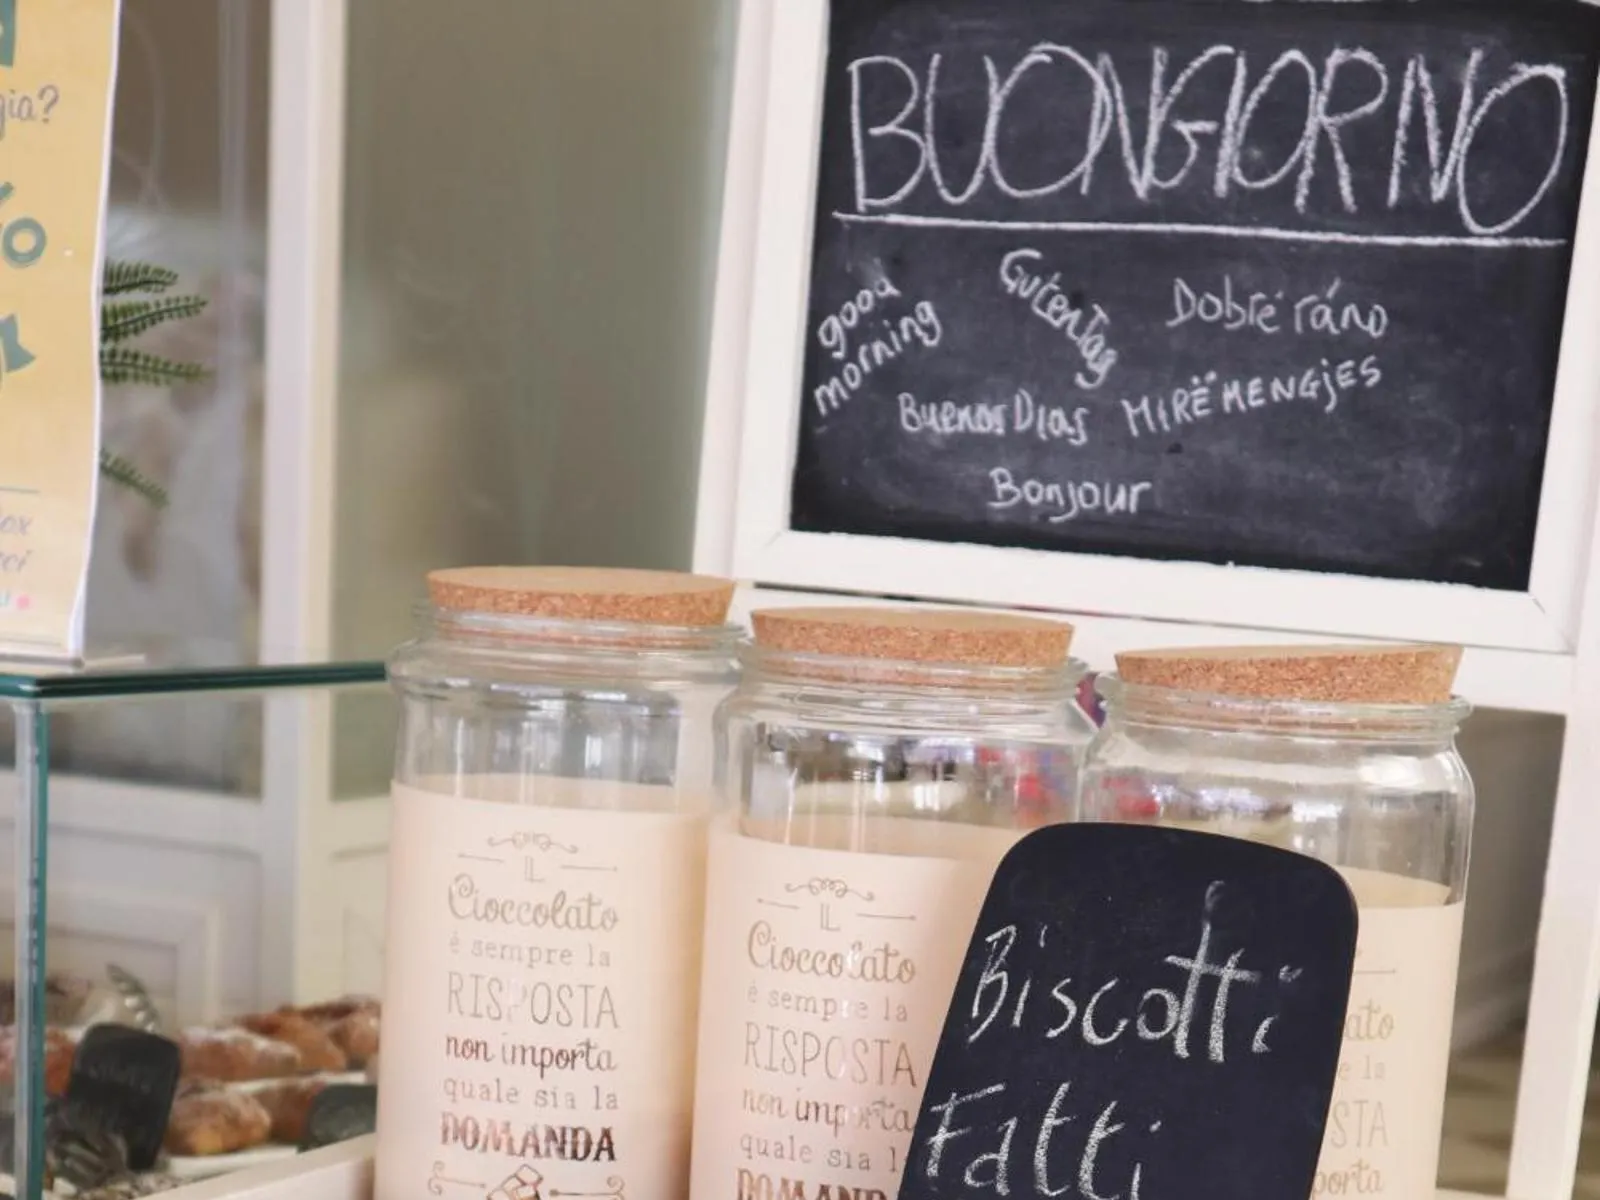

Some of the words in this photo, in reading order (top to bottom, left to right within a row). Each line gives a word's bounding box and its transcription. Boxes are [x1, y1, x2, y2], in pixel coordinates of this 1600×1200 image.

[848, 43, 1568, 235] BUONGIORNO
[818, 258, 901, 359] good
[813, 300, 942, 416] morning
[898, 392, 1007, 435] Buenos
[987, 466, 1151, 523] Bonjour
[447, 873, 620, 932] Cioccolato
[820, 902, 841, 932] IL
[470, 938, 573, 969] sempre
[586, 942, 612, 968] la
[968, 881, 1303, 1064] Biscotti
[883, 996, 909, 1023] la
[445, 1033, 496, 1063] non
[500, 1032, 618, 1080] importa
[744, 1021, 917, 1088] RISPOSTA
[1361, 1055, 1386, 1080] la
[442, 1074, 520, 1106] quale
[533, 1086, 577, 1110] sia
[592, 1084, 620, 1111] la
[743, 1088, 787, 1119] non
[440, 1111, 617, 1163] DOMANDA
[739, 1133, 813, 1161] quale
[827, 1147, 871, 1172] sia
